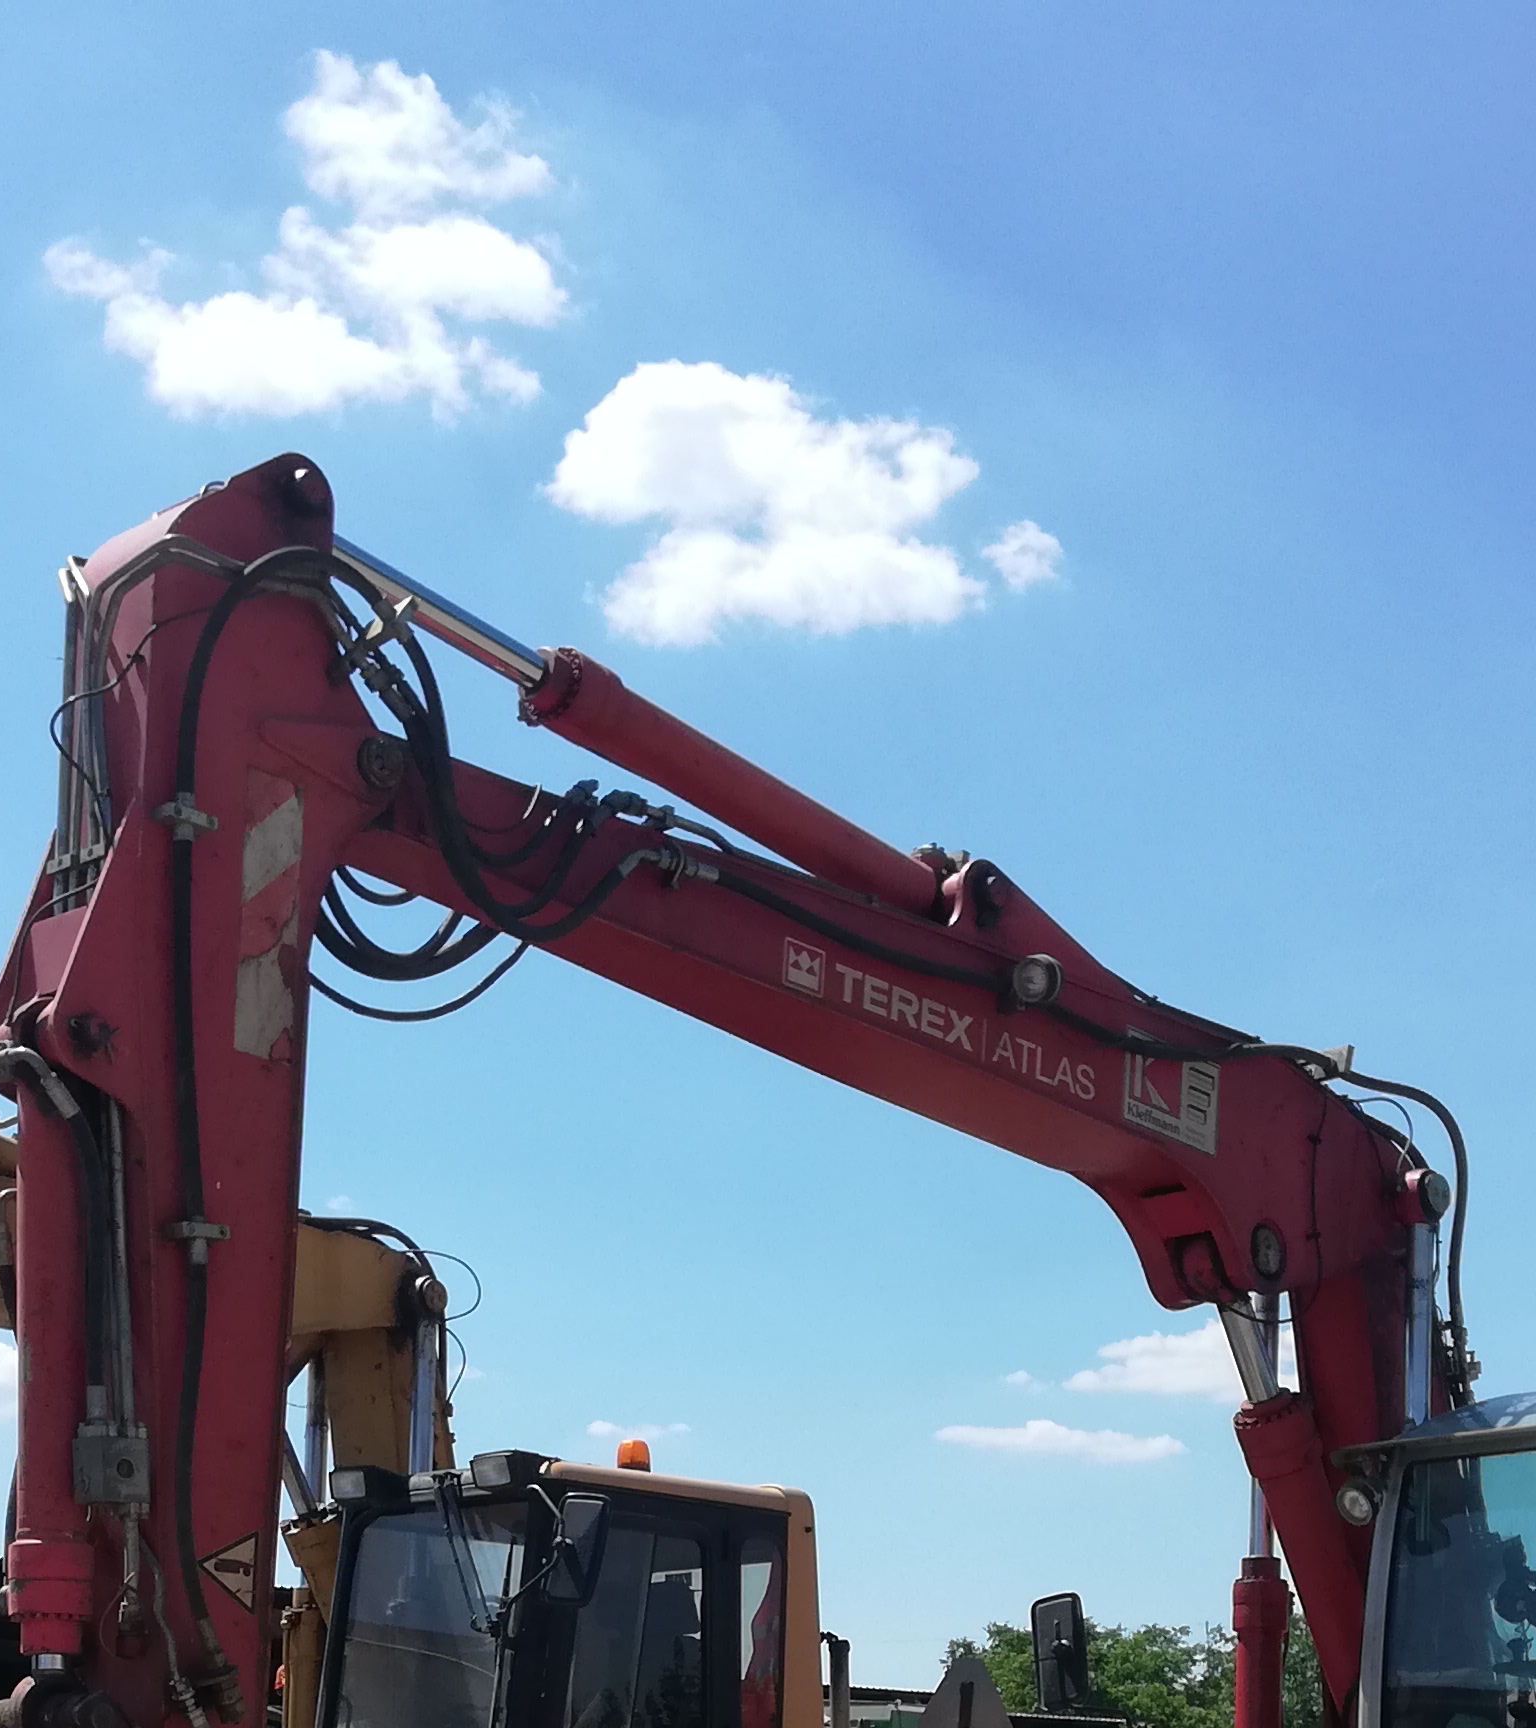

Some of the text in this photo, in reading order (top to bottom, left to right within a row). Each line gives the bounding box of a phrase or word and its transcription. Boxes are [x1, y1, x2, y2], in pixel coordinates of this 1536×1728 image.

[834, 962, 974, 1052] TEREX
[992, 1031, 1096, 1101] ATLAS
[1127, 1101, 1181, 1136] Kleffmann
